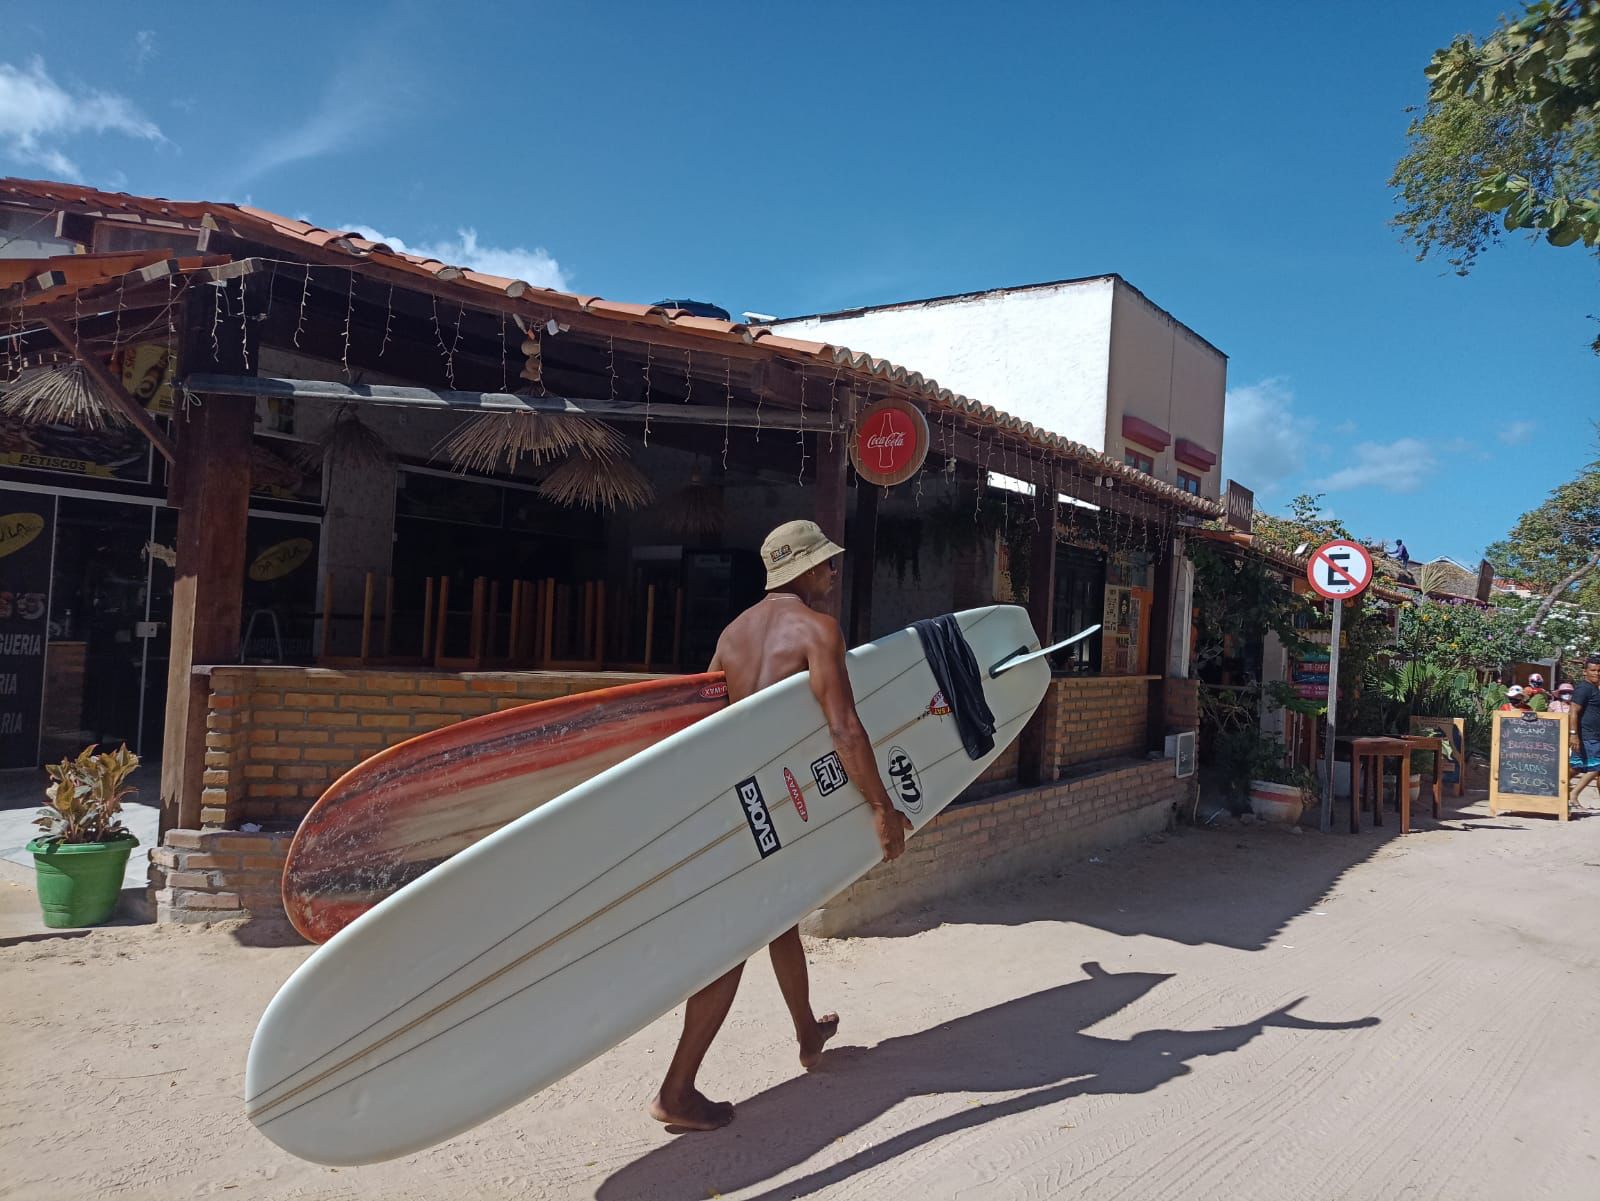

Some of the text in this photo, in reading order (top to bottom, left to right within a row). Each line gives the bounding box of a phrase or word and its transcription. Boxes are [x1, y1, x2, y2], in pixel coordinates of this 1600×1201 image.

[20, 454, 87, 471] PETISCOS
[1327, 553, 1350, 586] E
[1511, 772, 1549, 790] SUCOS
[739, 782, 777, 853] EVOKE
